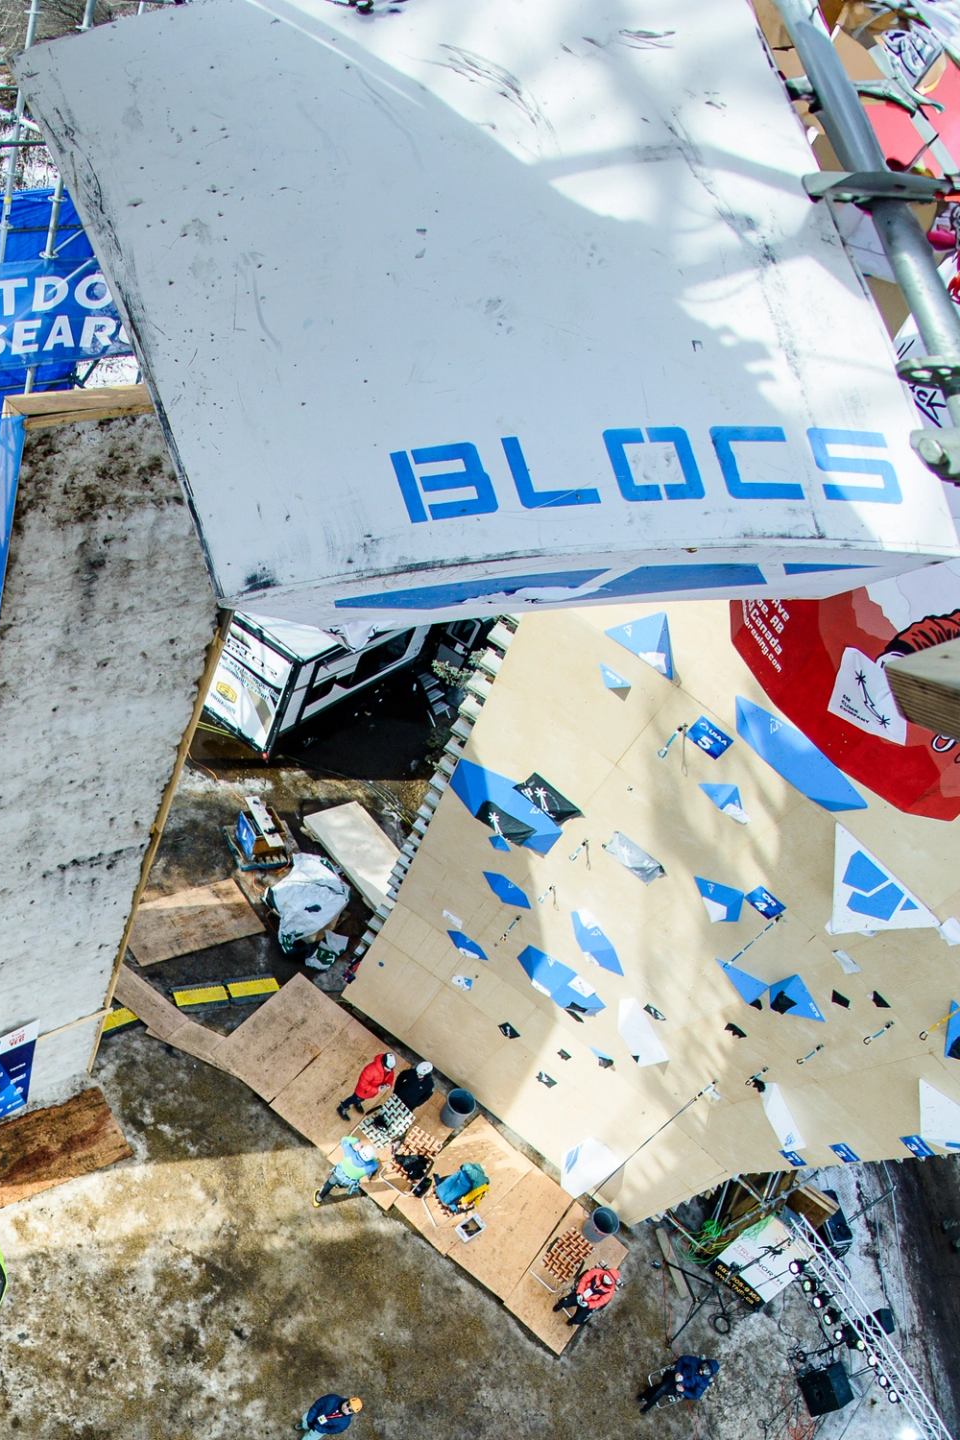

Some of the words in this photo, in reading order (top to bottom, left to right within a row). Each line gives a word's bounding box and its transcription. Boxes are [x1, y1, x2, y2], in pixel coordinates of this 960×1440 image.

[389, 425, 903, 524] BLOCS
[750, 608, 782, 655] Canada
[697, 735, 714, 750] 5
[754, 900, 768, 913] 4
